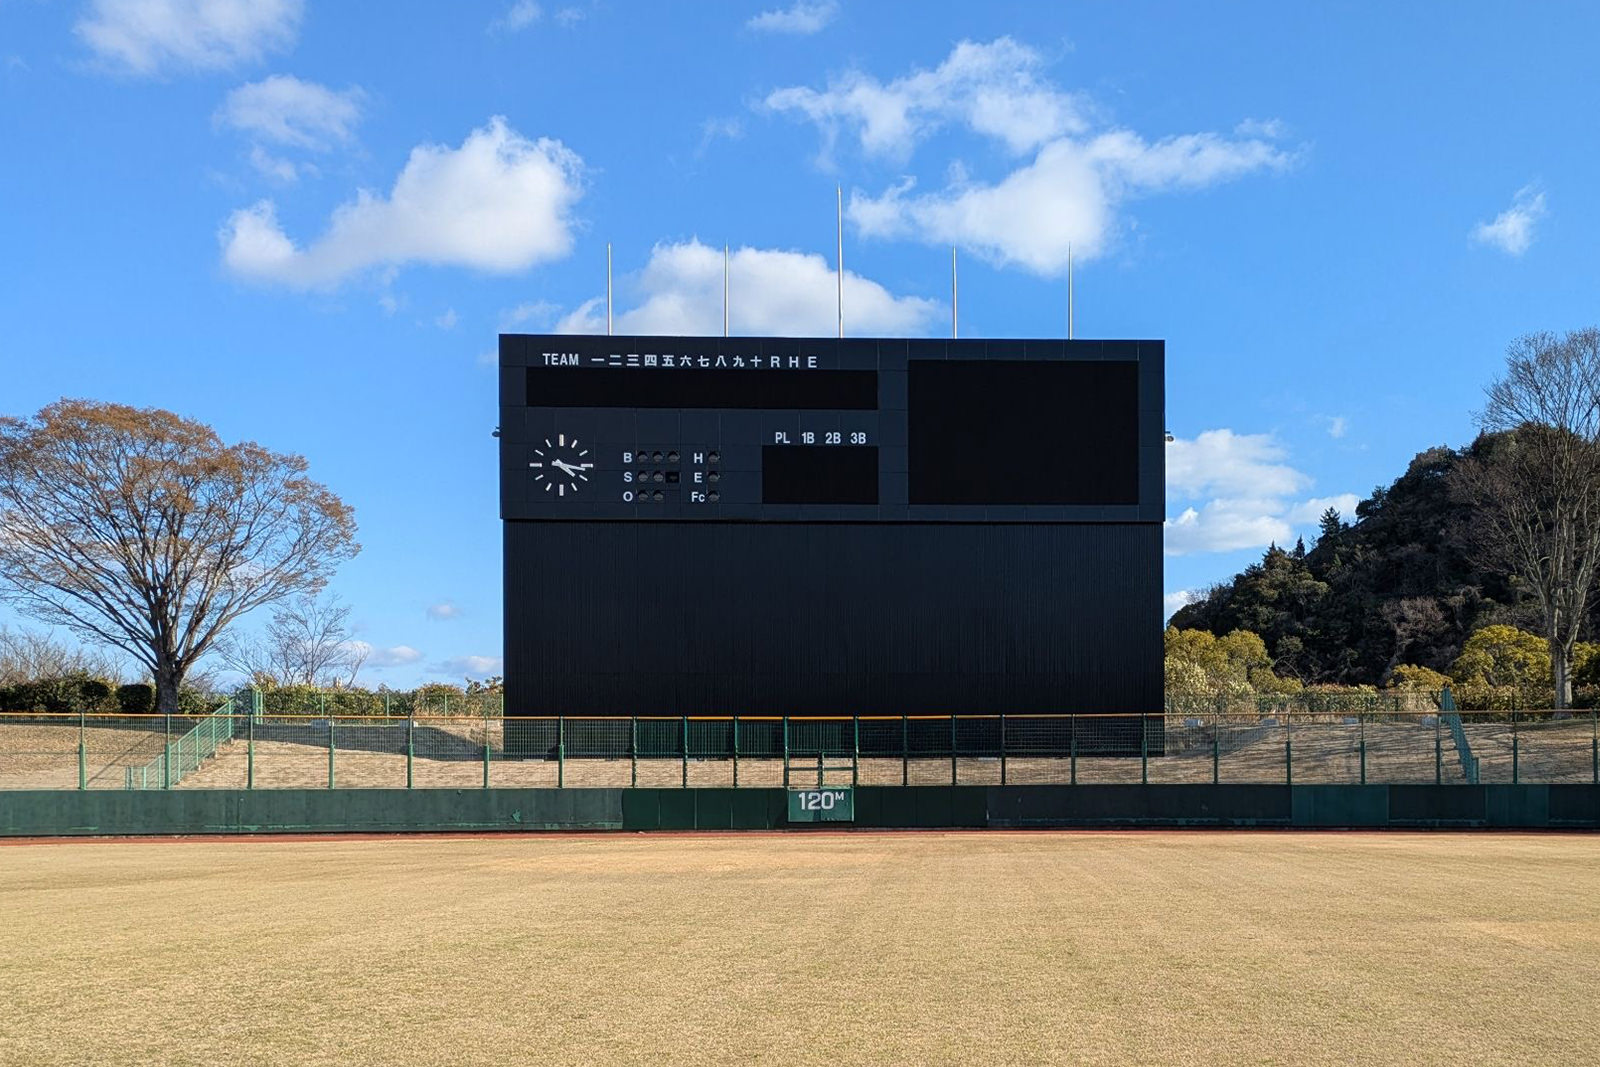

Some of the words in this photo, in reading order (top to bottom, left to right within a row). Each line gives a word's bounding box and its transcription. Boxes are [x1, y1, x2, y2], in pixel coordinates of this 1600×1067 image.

[542, 353, 579, 367] TEAM
[770, 355, 781, 368] R
[788, 355, 799, 368] H
[807, 355, 818, 369] E
[775, 431, 790, 444] PL
[801, 431, 815, 444] 1B
[825, 431, 842, 444] 2B
[850, 431, 867, 445] 3B
[623, 452, 633, 463] B
[693, 452, 703, 463] H
[623, 471, 633, 483] S
[694, 472, 703, 483] E
